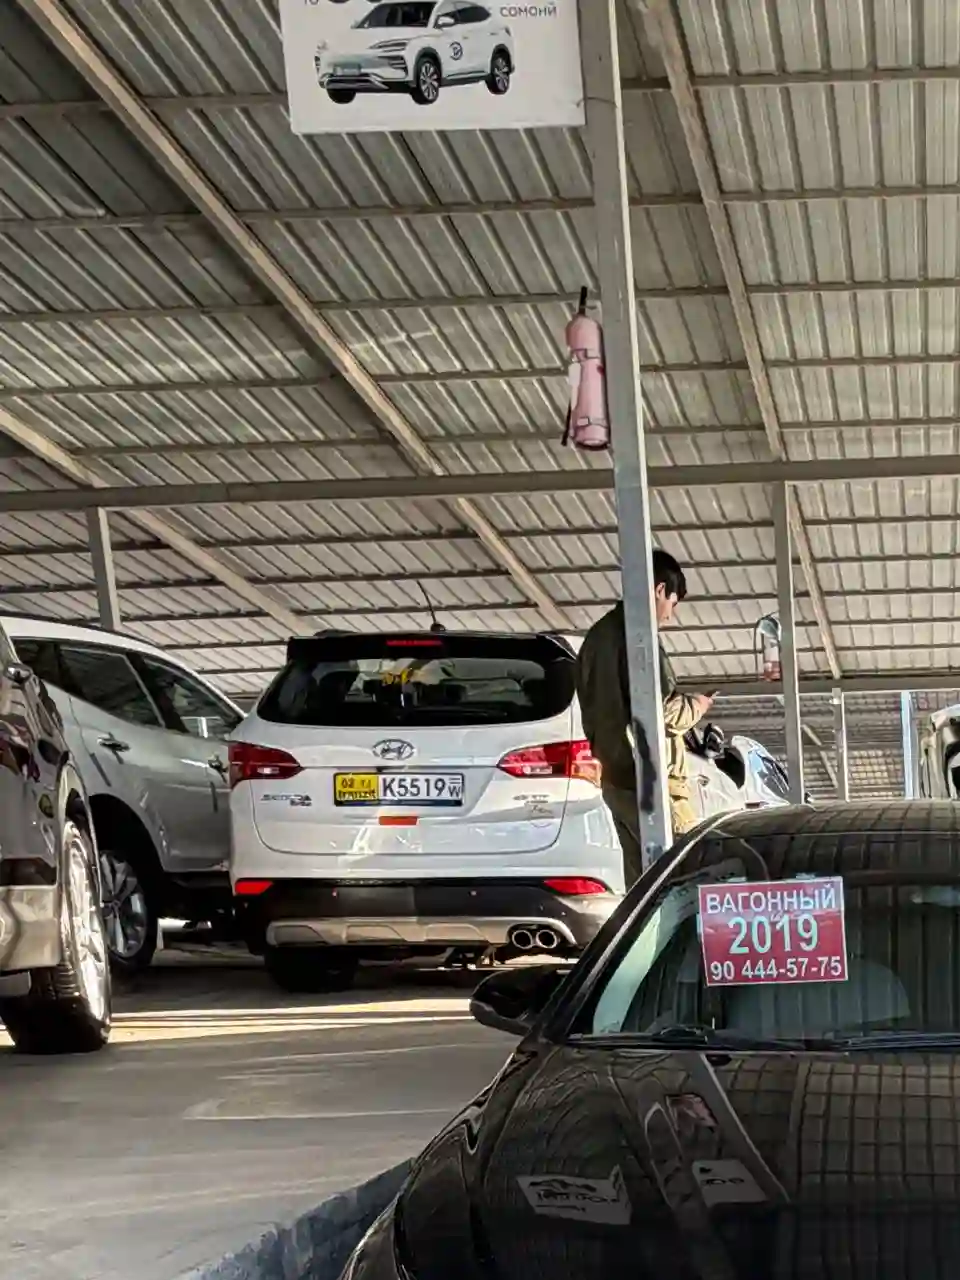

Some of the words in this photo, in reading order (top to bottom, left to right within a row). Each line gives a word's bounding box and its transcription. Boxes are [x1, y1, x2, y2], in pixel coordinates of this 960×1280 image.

[382, 778, 446, 797] K5519
[705, 884, 837, 914] ВАГОННЫЙ
[727, 914, 819, 954] 2019
[710, 960, 735, 981] 90
[741, 956, 842, 979] 444-57-75
